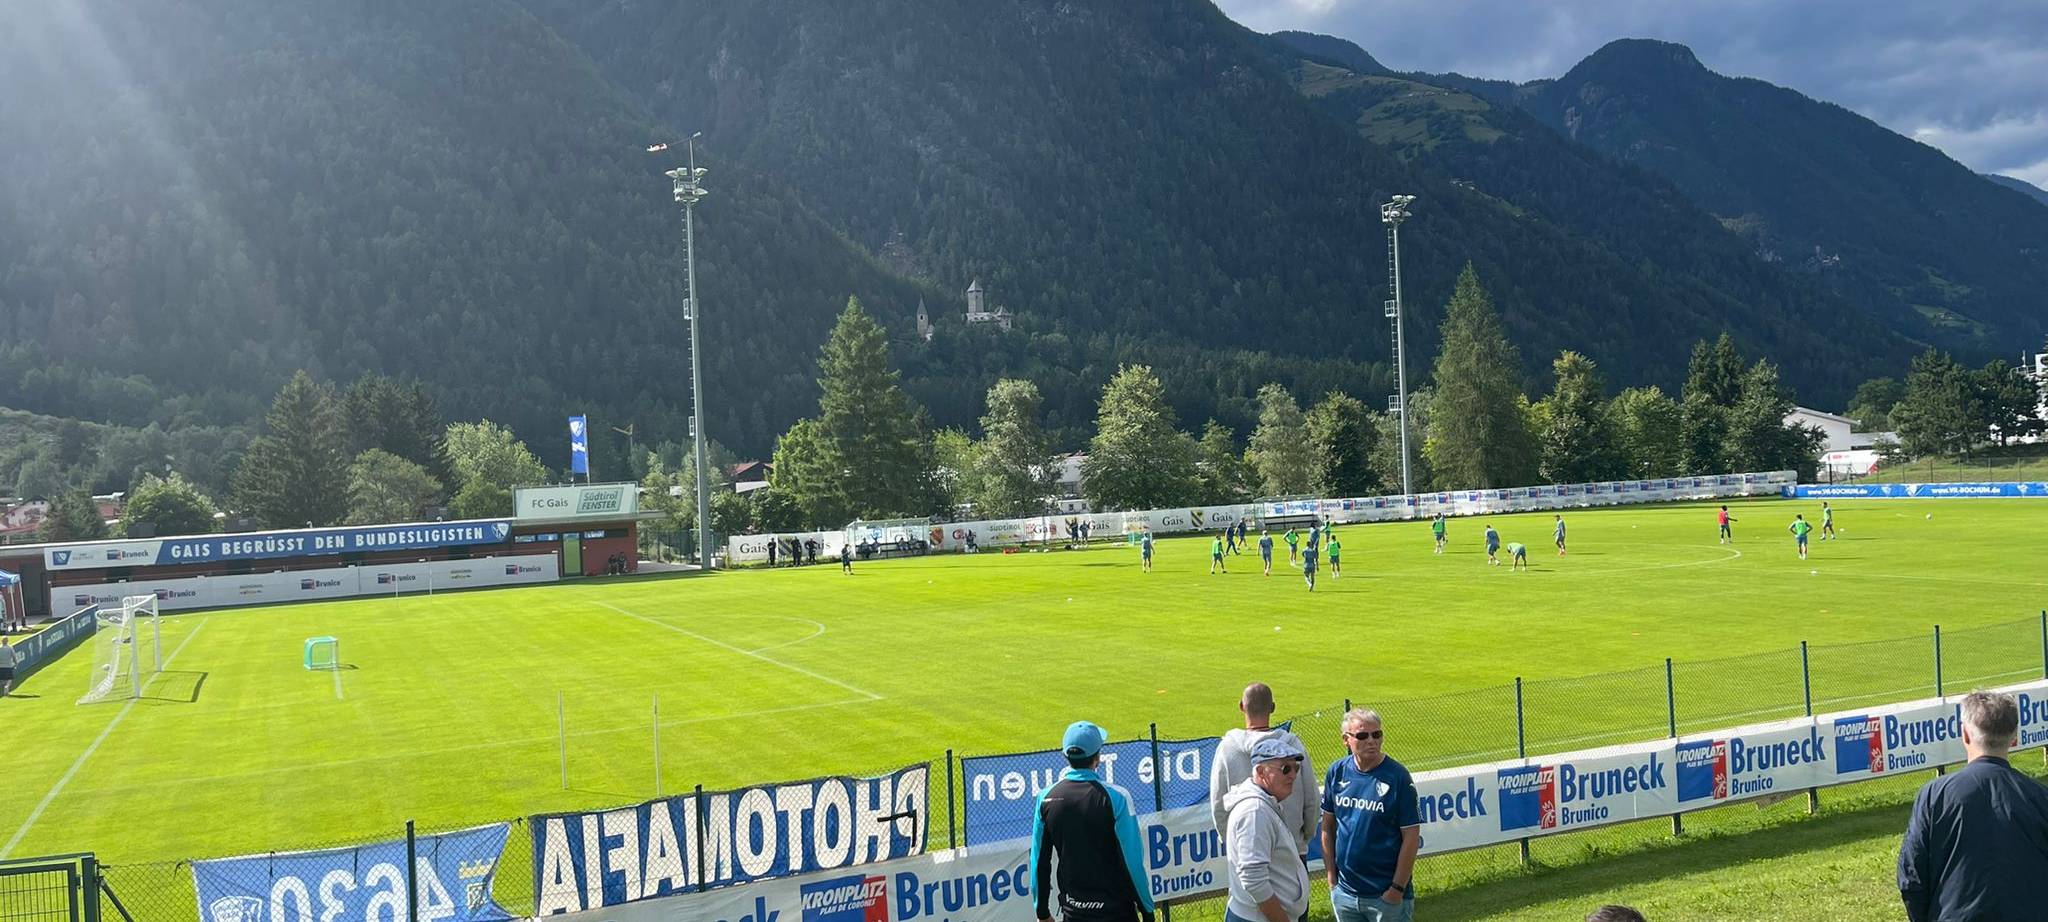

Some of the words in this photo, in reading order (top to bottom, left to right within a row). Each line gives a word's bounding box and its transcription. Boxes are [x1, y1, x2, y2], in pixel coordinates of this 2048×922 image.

[532, 500, 544, 508] FC
[547, 499, 569, 508] Gais
[582, 501, 616, 510] FENSTER
[584, 491, 618, 501] Südtirol
[1162, 516, 1184, 526] Gais
[1212, 512, 1233, 522] Gais
[171, 541, 210, 558] GAIS
[222, 536, 304, 555] BEGRÜSST
[315, 535, 345, 549] DEN
[355, 527, 483, 547] BUNDESLIGISTEN
[740, 542, 767, 554] Gais
[122, 550, 149, 558] Bruneck
[392, 573, 416, 582] Bunico
[169, 589, 196, 598] Brunico
[1835, 720, 1880, 737] KRONPLATZ
[1676, 744, 1725, 763] KRONPLATZ
[1730, 726, 1826, 775] Bruneck
[1888, 750, 1926, 770] Brunico
[1498, 770, 1554, 790] KRONPLATZ
[1560, 751, 1666, 803] Bruneck
[1732, 775, 1773, 795] Brunico
[1419, 777, 1487, 824] neck
[1562, 805, 1609, 826] Brunico
[896, 863, 1030, 916] Brunec
[1151, 868, 1213, 896] Brunico
[801, 881, 886, 911] KRONPLATZ
[820, 906, 836, 915] PLAN
